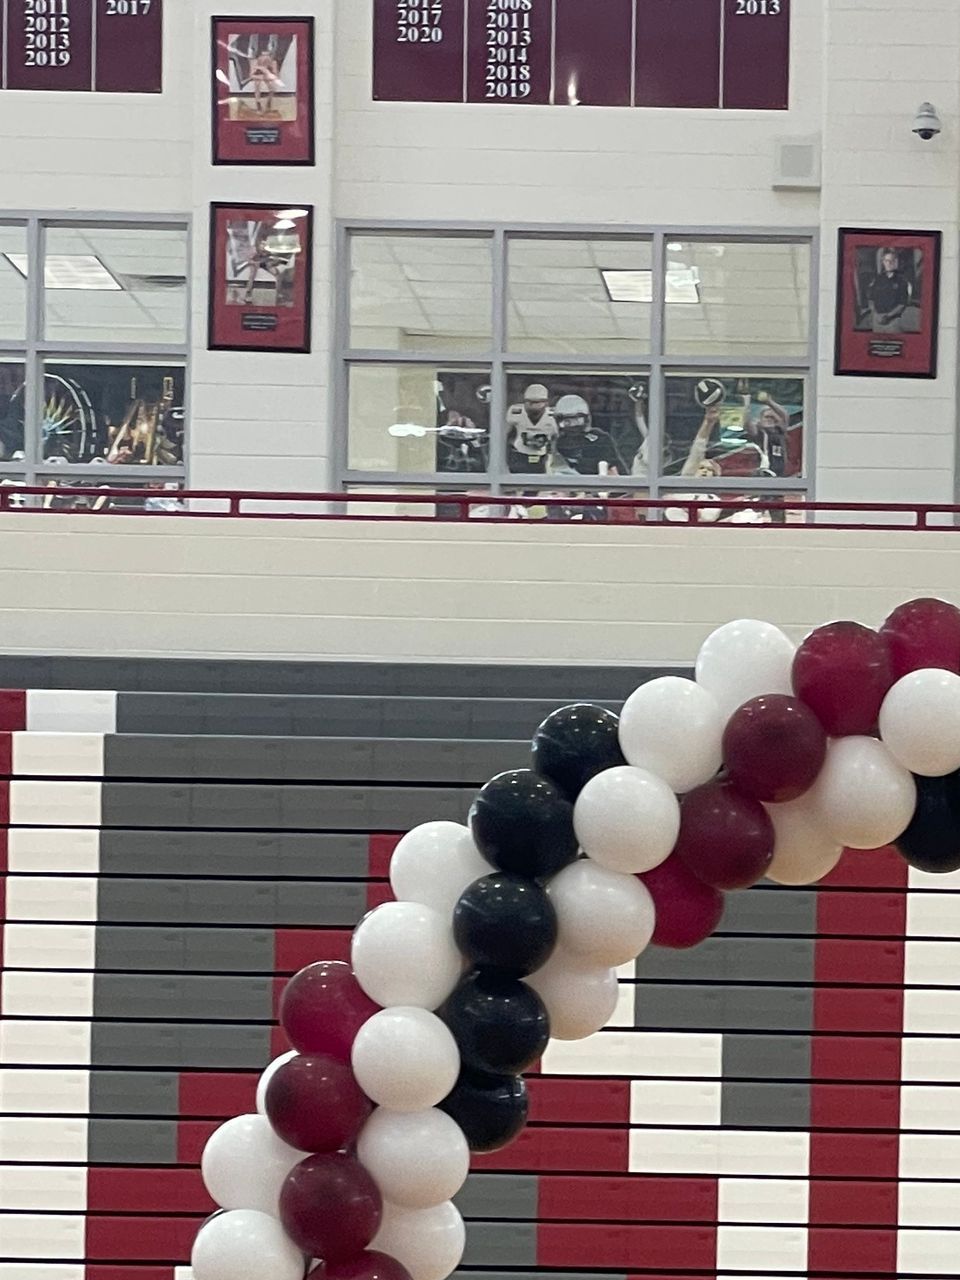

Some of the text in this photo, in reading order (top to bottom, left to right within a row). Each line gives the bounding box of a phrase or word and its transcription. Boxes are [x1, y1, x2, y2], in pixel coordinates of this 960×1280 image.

[24, 0, 69, 14] 2011
[105, 0, 151, 15] 2017
[735, 0, 780, 15] 2013
[24, 16, 70, 32] 2012
[397, 9, 442, 25] 2017
[486, 12, 530, 28] 2011
[24, 33, 70, 49] 2013
[397, 26, 442, 43] 2020
[486, 29, 531, 46] 2013
[24, 50, 70, 66] 2019
[487, 47, 527, 63] 2014
[485, 64, 531, 80] 2018
[485, 82, 531, 98] 2019
